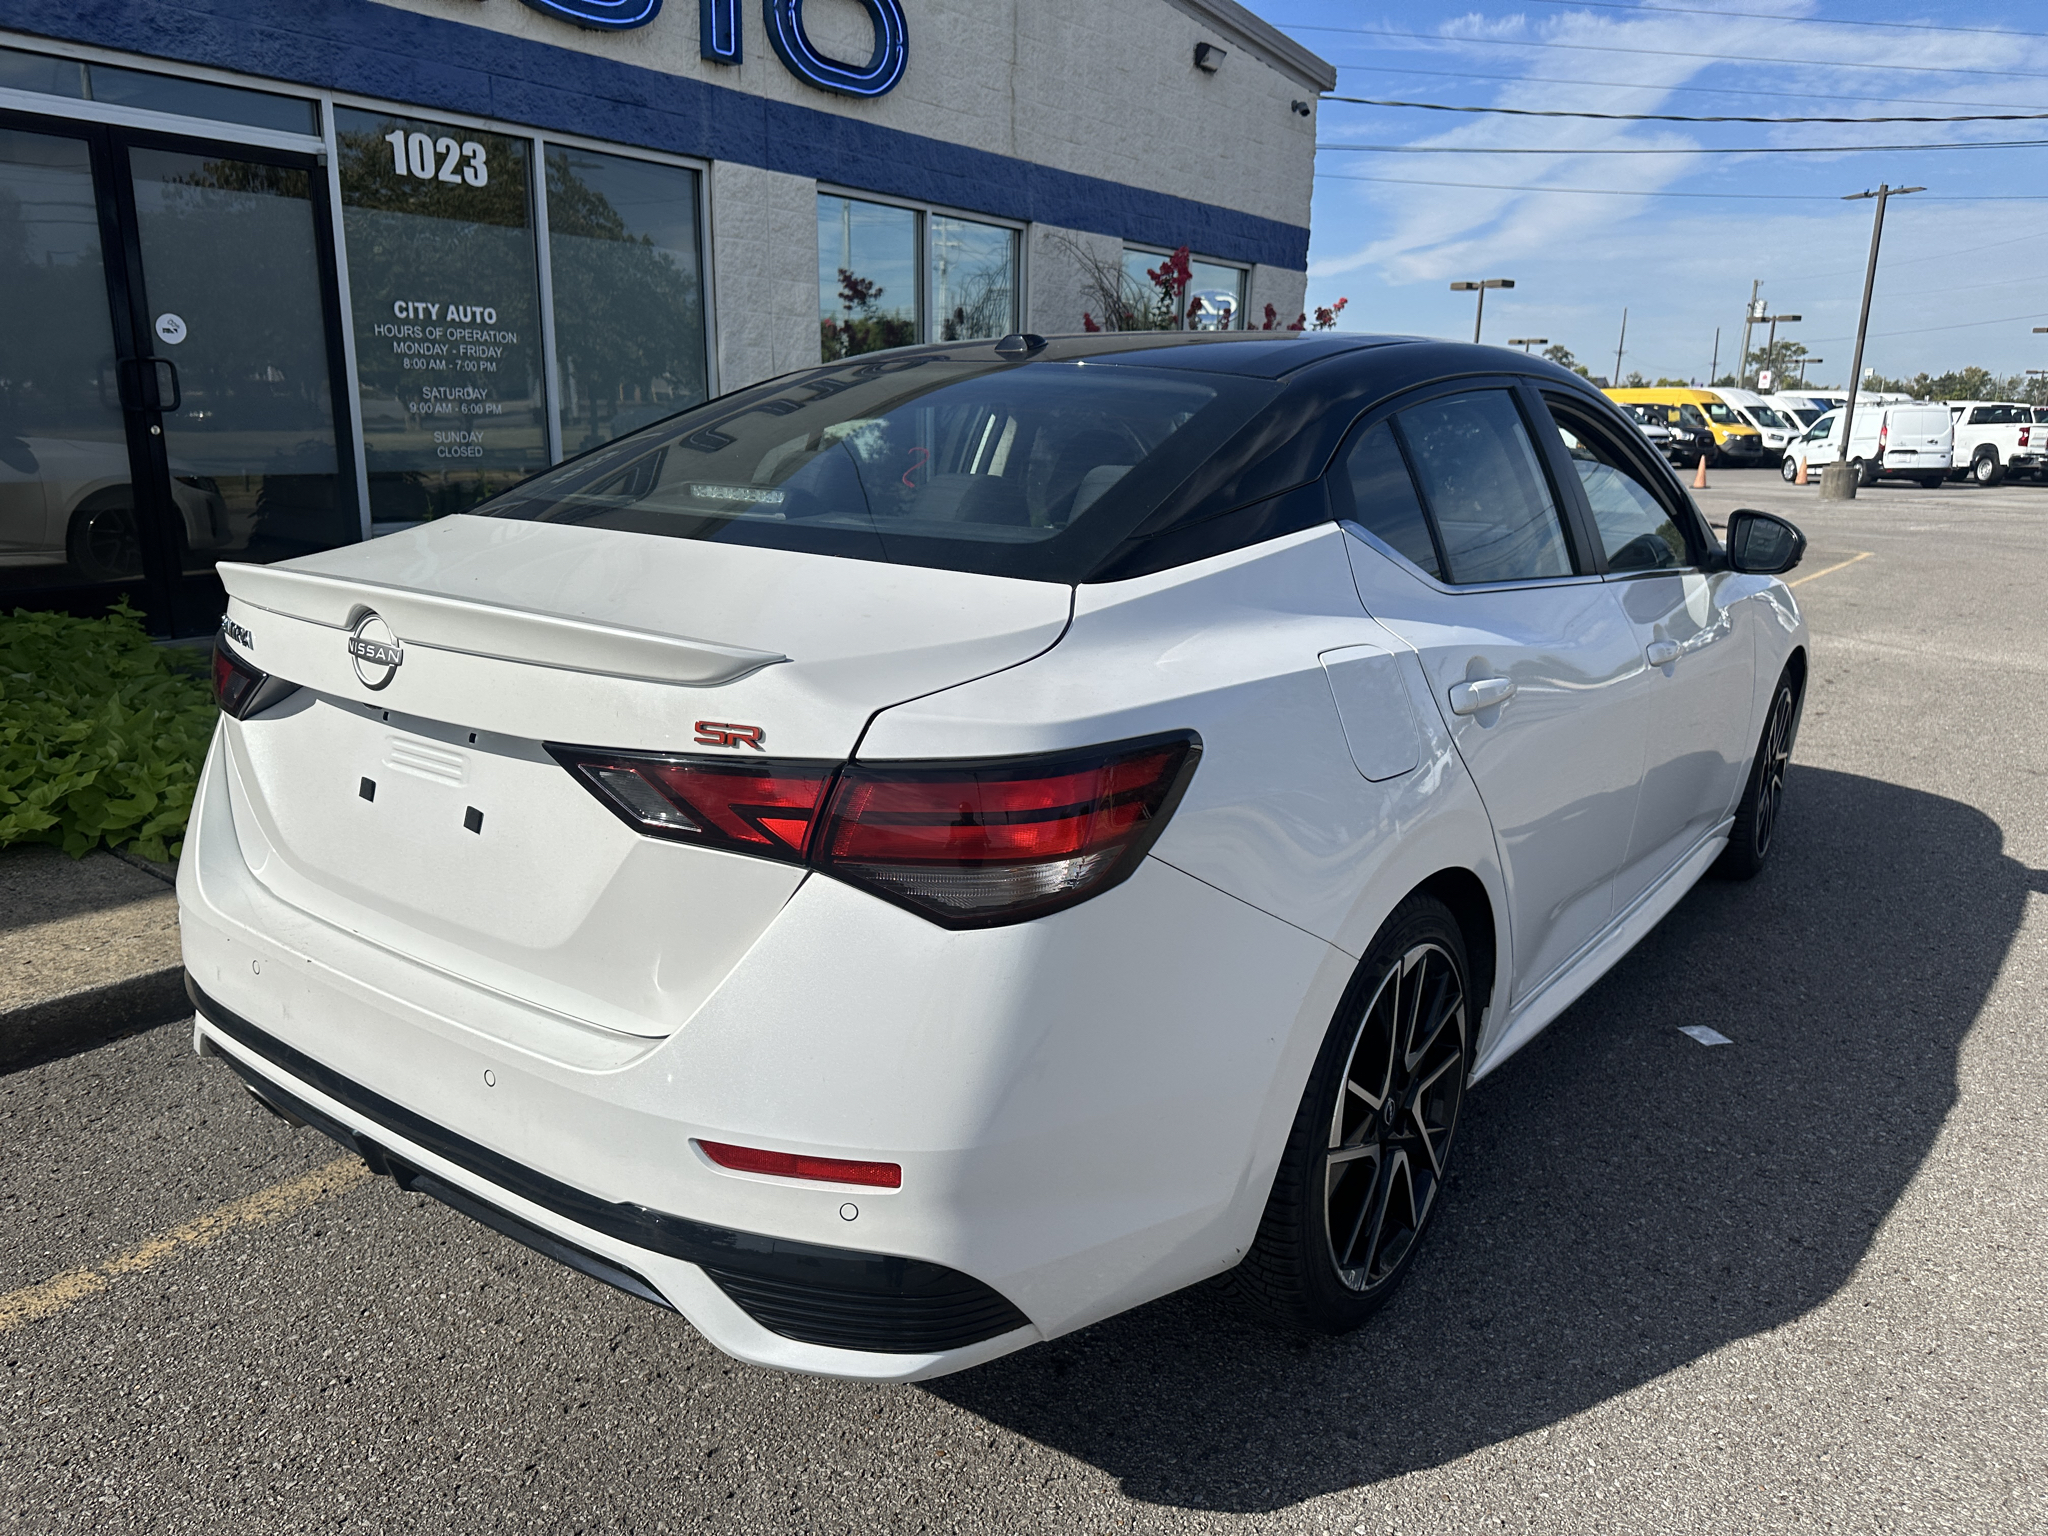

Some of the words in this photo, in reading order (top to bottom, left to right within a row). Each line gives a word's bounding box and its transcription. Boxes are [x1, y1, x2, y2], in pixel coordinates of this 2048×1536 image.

[385, 129, 489, 188] 1023
[393, 300, 440, 320] CITY
[446, 304, 497, 324] AUTO
[374, 323, 423, 338] HOURS
[425, 326, 444, 340] OF
[446, 327, 517, 344] OPERATION
[393, 341, 449, 356] MONDAY
[459, 344, 503, 358] FRIDAY
[403, 357, 427, 370] 8:00
[428, 359, 446, 371] AM
[455, 360, 478, 372] 7:00
[479, 361, 497, 373] PM
[422, 386, 488, 400] SATURDAY
[409, 402, 433, 414] 9:00
[434, 402, 452, 414] AM
[461, 403, 483, 415] 6:00
[485, 403, 502, 415] PM
[433, 431, 484, 443] SUNDAY
[437, 446, 483, 458] CLOSED
[349, 640, 400, 663] NISSAN
[693, 720, 764, 749] SR
